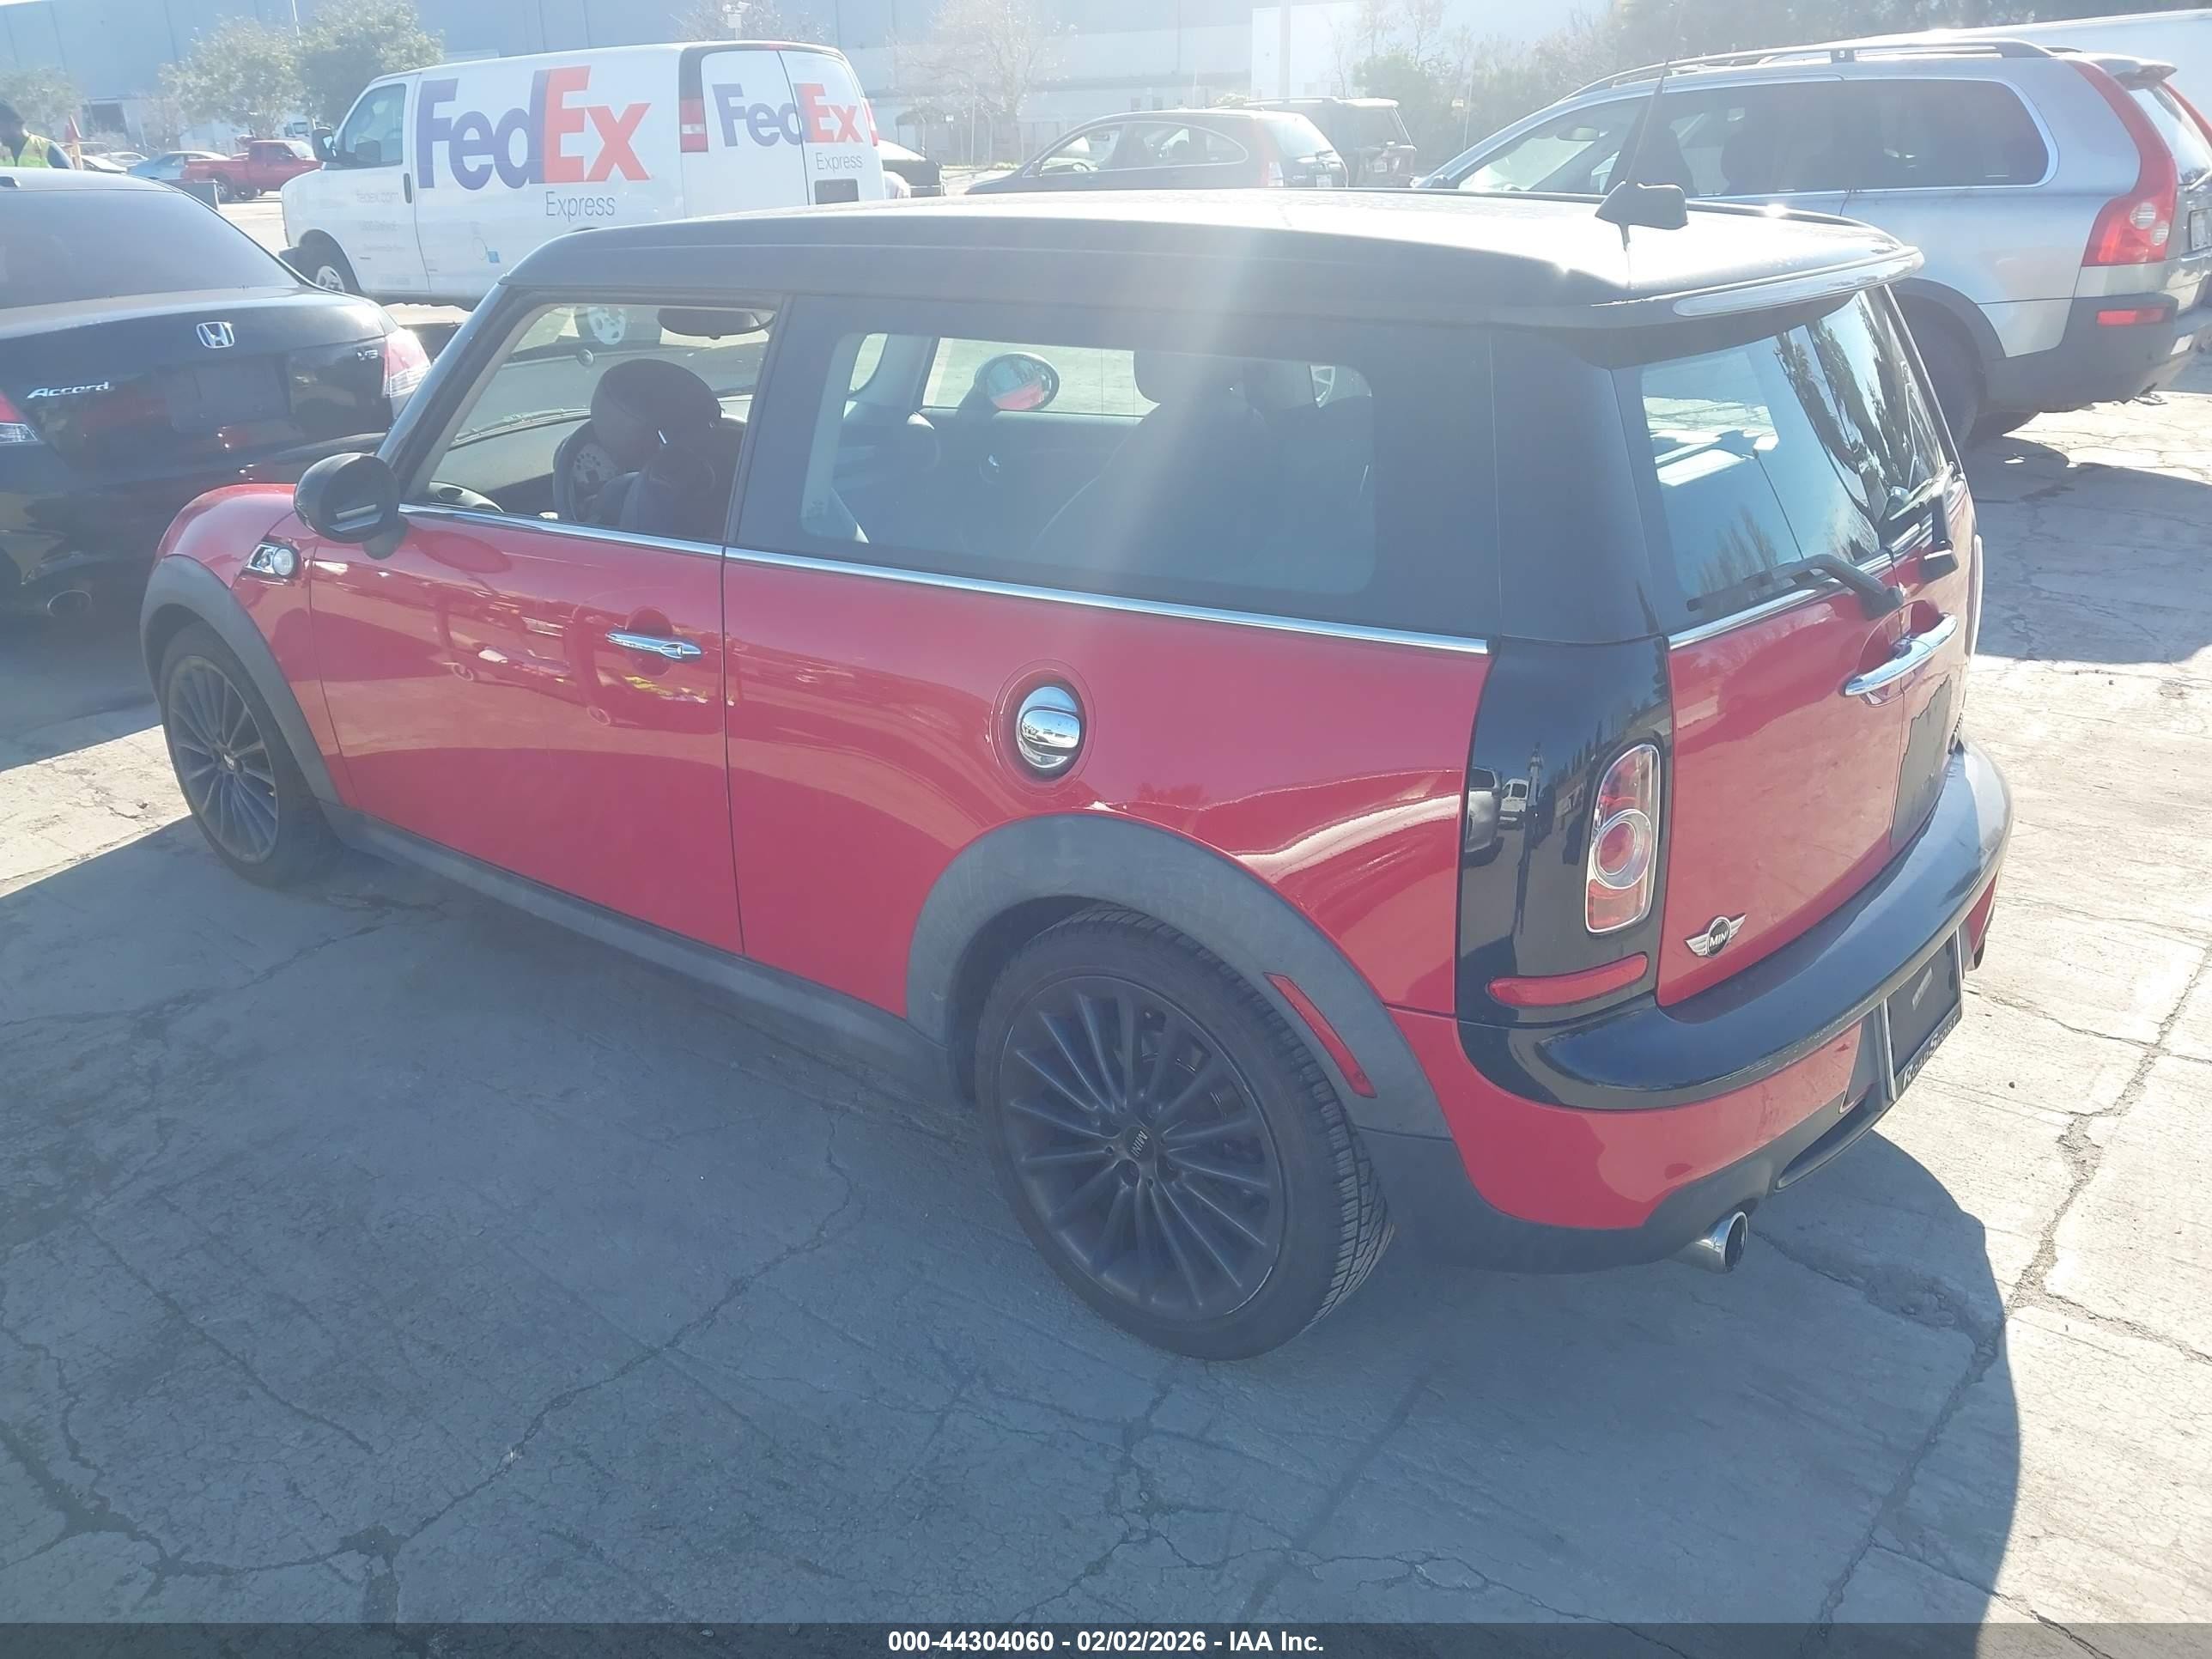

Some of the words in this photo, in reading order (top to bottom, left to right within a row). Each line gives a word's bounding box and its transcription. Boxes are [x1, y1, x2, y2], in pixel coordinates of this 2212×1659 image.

[416, 64, 653, 191] FedEx
[711, 82, 864, 148] FedEx
[816, 152, 863, 176] Express
[545, 191, 616, 222] Express
[27, 381, 109, 399] Accord
[1709, 930, 1729, 948] MINI
[1131, 1130, 1148, 1158] MINI
